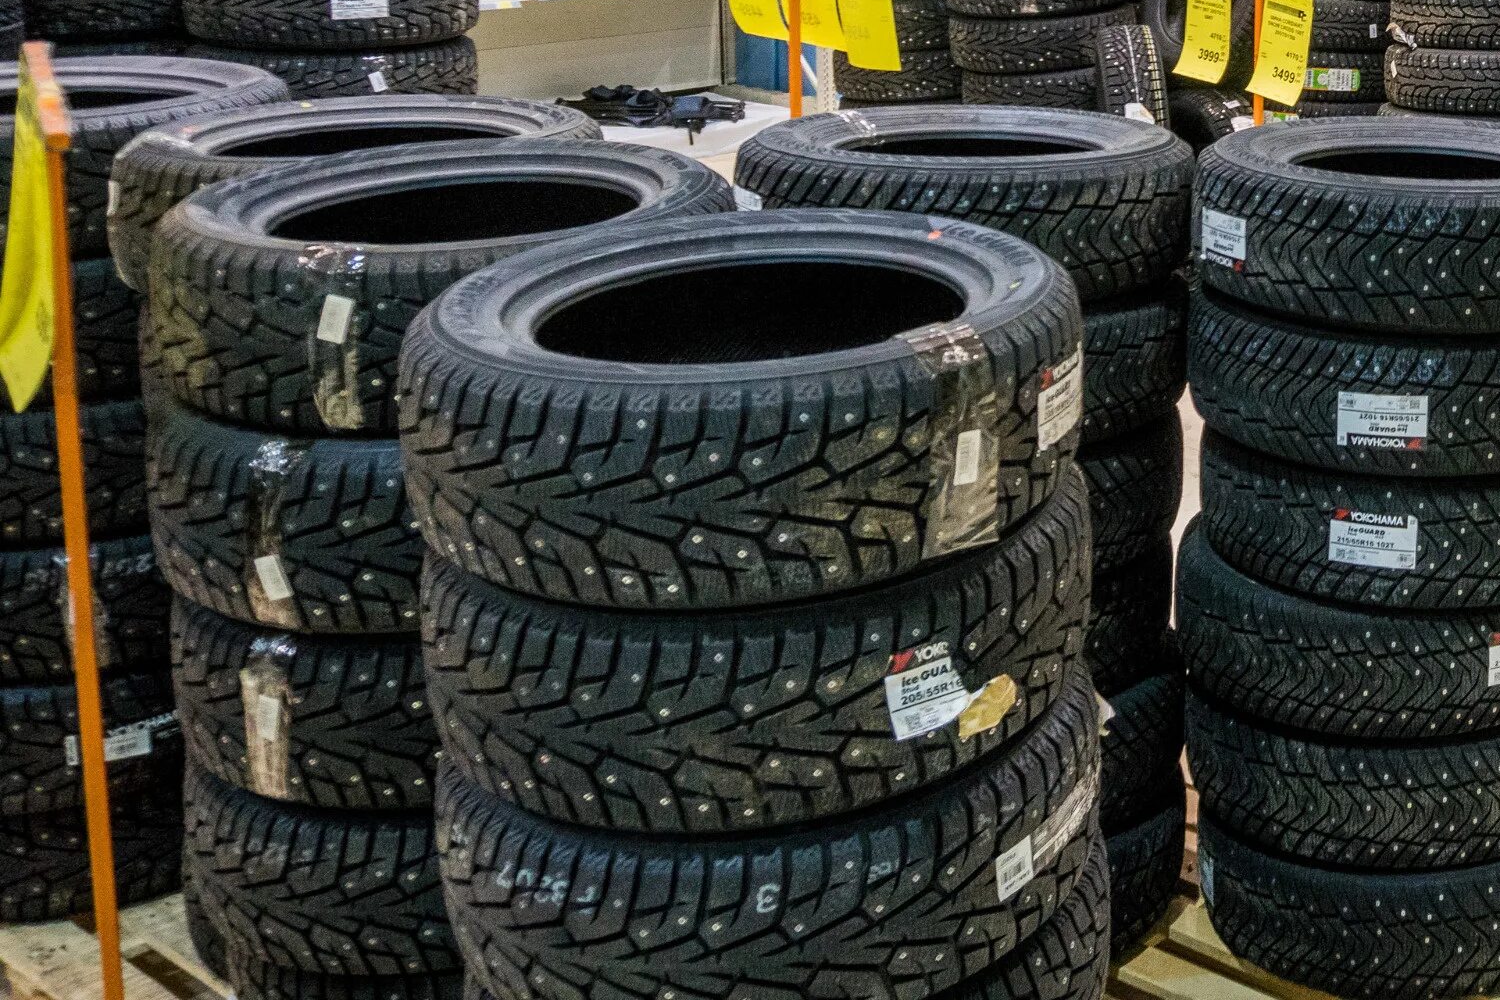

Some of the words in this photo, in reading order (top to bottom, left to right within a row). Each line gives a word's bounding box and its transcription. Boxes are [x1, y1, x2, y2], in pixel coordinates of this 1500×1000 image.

[1198, 48, 1219, 63] 3999
[1272, 66, 1295, 84] 3499
[1350, 435, 1406, 449] YOKOHAMA
[1350, 511, 1404, 526] YOKOHAMA
